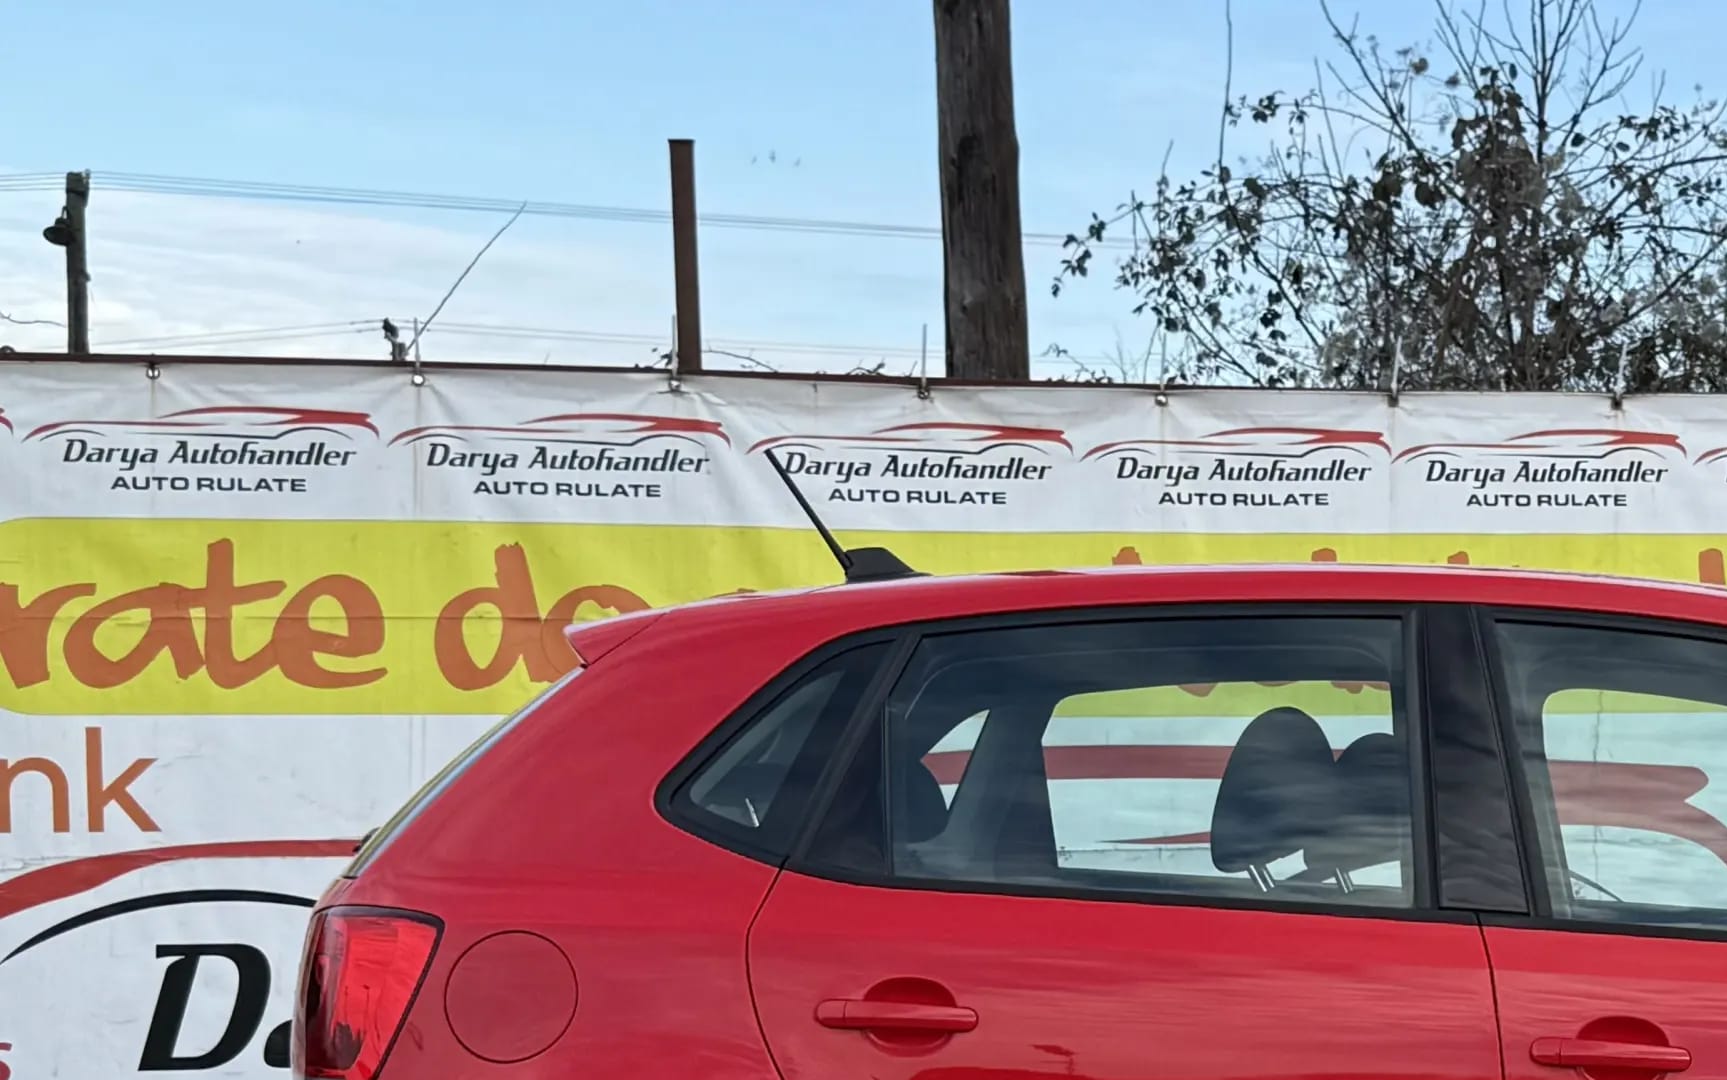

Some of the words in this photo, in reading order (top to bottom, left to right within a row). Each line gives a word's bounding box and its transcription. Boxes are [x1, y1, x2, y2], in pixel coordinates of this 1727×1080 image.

[63, 439, 158, 471] Darya
[168, 440, 357, 466] Autohandler
[427, 443, 518, 476] Darya
[528, 446, 710, 472] Autohandler
[785, 452, 872, 484] Darya
[880, 455, 1052, 480] Autohandler
[111, 476, 189, 491] AUTO
[197, 477, 306, 492] RULATE
[1117, 457, 1200, 487] Darya
[1208, 459, 1372, 481] Autohandler
[1426, 460, 1505, 489] Darya
[1513, 461, 1668, 483] Autohandler
[473, 481, 548, 495] AUTO
[556, 482, 661, 498] RULATE
[828, 488, 900, 503] AUTO
[907, 490, 1006, 504] RULATE
[1158, 492, 1226, 506] AUTO
[1233, 493, 1329, 506] RULATE
[1466, 494, 1531, 507] AUTO
[1537, 494, 1627, 507] RULATE
[0, 538, 388, 689] rate
